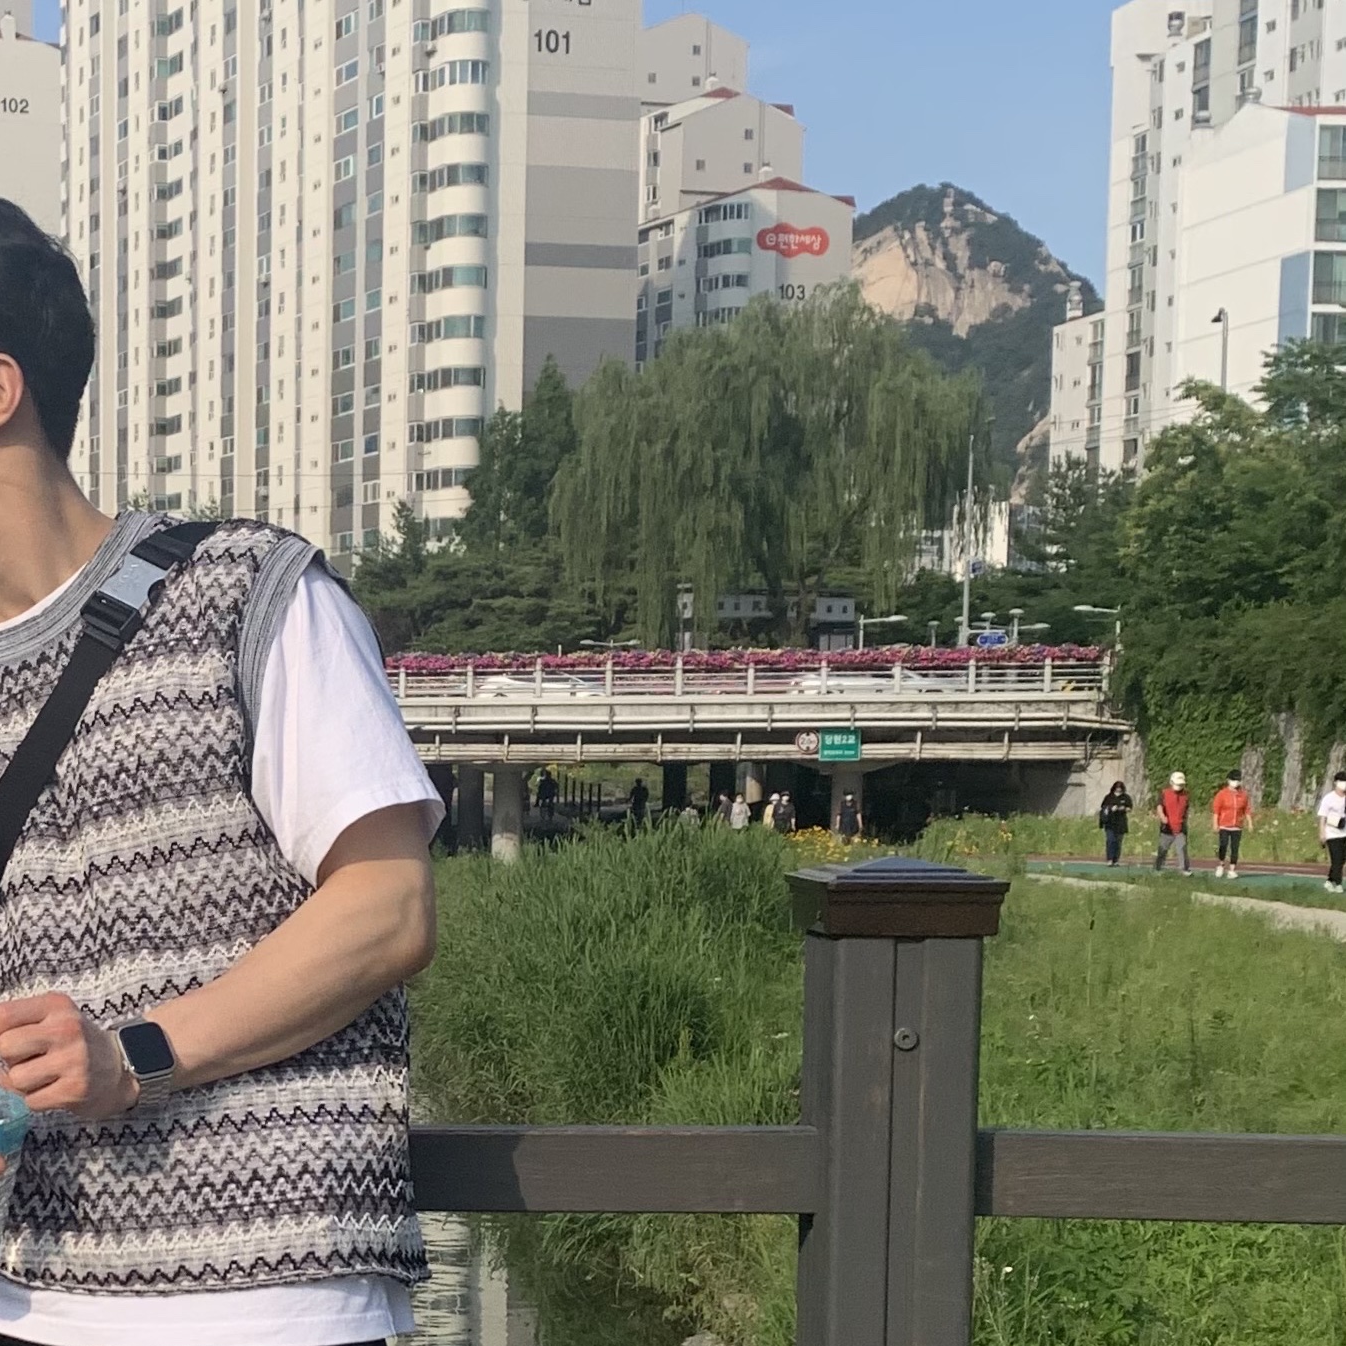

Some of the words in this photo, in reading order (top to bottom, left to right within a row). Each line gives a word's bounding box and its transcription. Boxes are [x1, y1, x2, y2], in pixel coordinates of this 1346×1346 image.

[534, 29, 570, 54] 101
[0, 97, 29, 113] 102
[779, 283, 805, 300] 103
